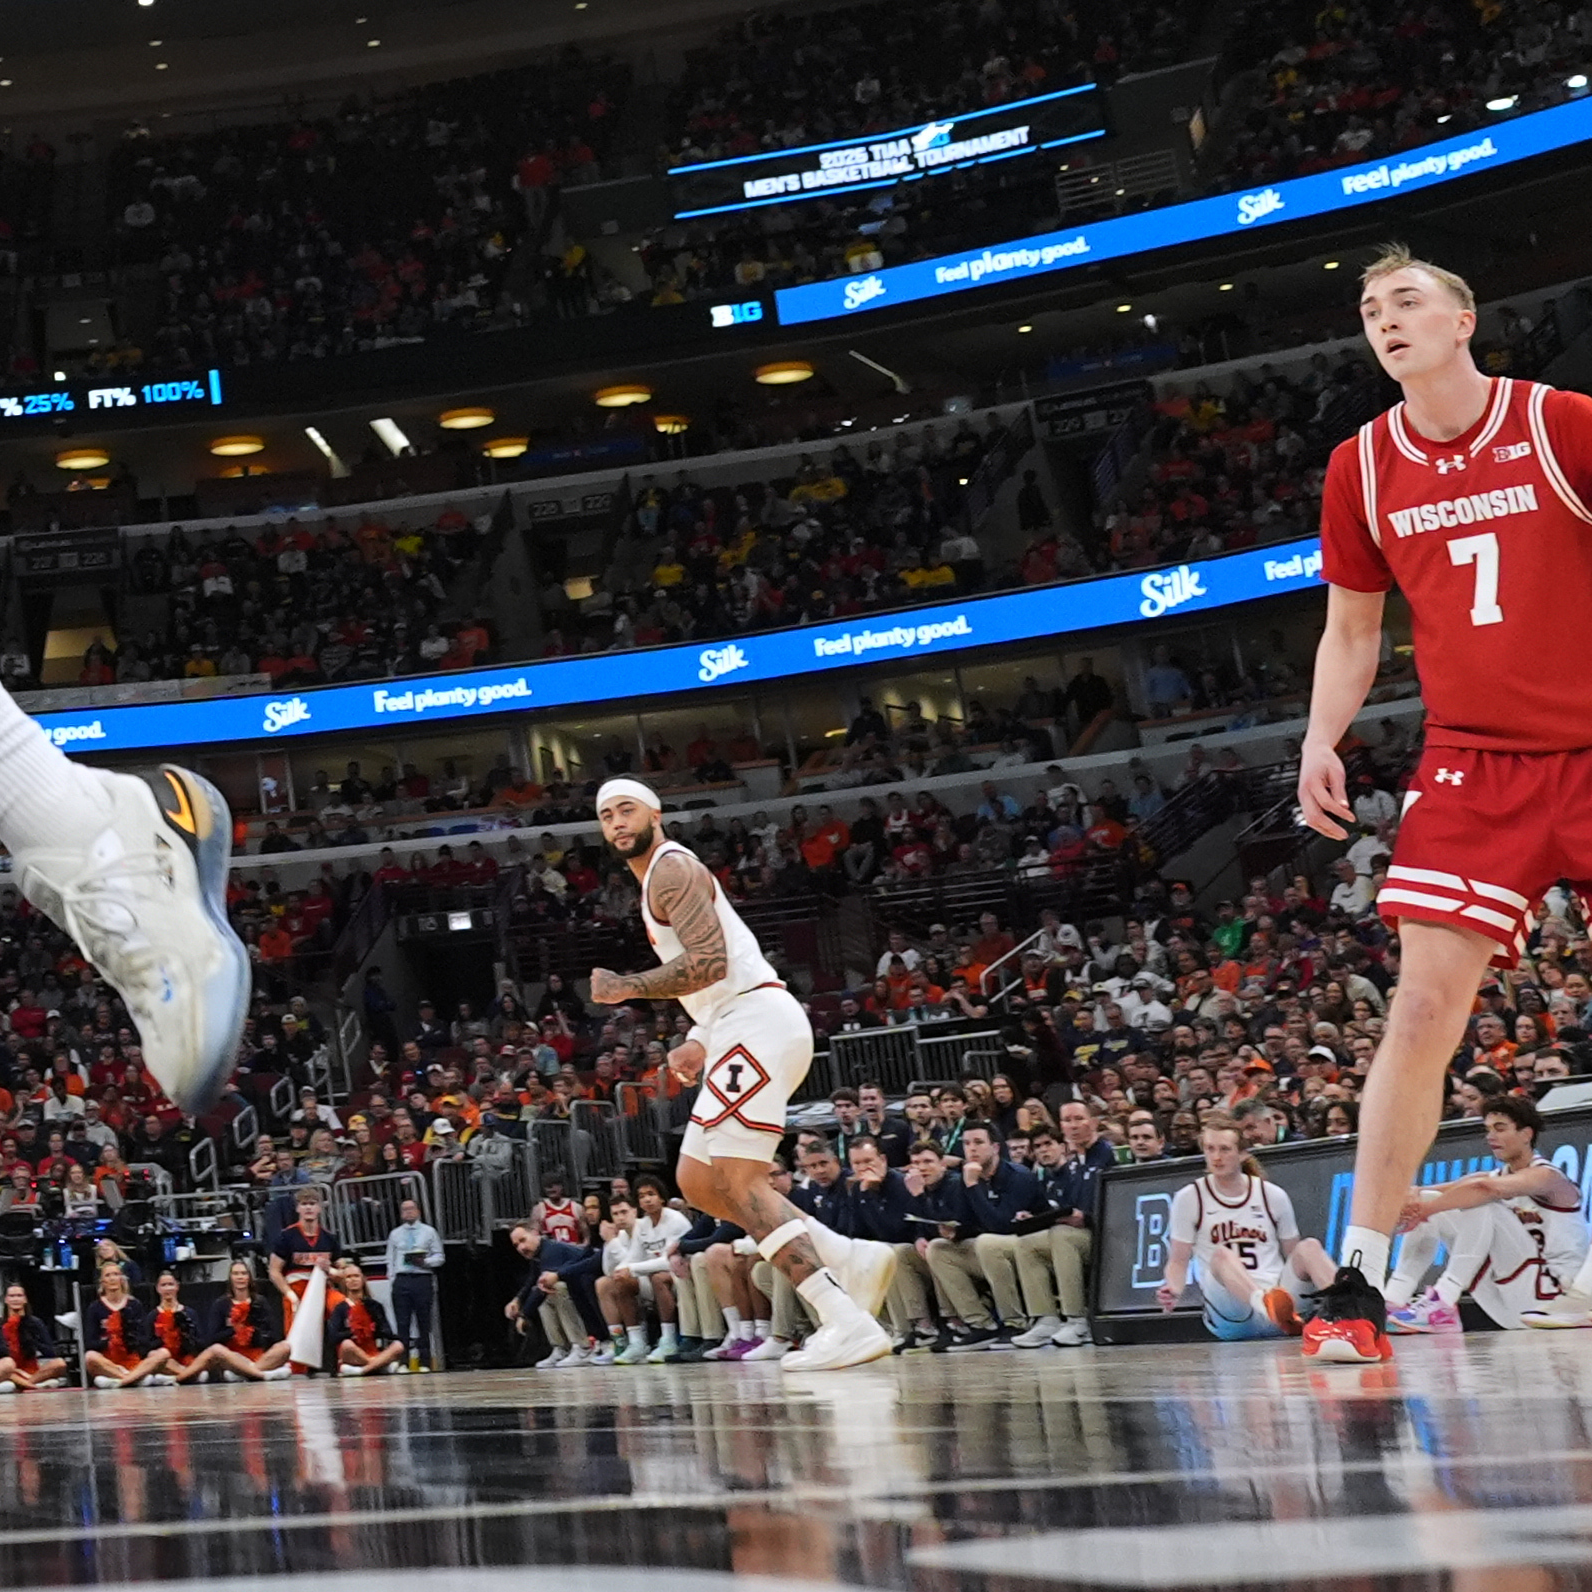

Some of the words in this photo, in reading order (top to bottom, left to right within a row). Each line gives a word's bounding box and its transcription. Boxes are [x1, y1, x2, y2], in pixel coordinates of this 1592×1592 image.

[743, 173, 800, 198] MEN'S
[801, 155, 914, 189] BASKETBALL
[914, 125, 1030, 168] TOURNAMENT
[1342, 165, 1391, 195] Feel
[1389, 155, 1447, 187] planty
[1445, 137, 1498, 171] good.
[1237, 187, 1288, 226] Silk
[935, 261, 970, 284] Feel
[968, 248, 1041, 281] planty
[1039, 236, 1091, 265] good.
[843, 274, 889, 311] Silk
[24, 392, 74, 416] 25%
[88, 386, 137, 410] FT%
[140, 380, 204, 405] 100%
[1387, 484, 1539, 539] WISCONSIN
[1139, 563, 1210, 620] Silk
[1446, 532, 1504, 627] 7
[813, 633, 853, 657] Feel
[852, 627, 915, 655] planty
[913, 615, 973, 645] good.
[698, 643, 751, 680] Silk
[263, 696, 314, 734] Silk
[373, 690, 415, 713] Feel
[414, 687, 477, 713] planty
[475, 678, 533, 706] good.
[1210, 1221, 1268, 1245] Illinois
